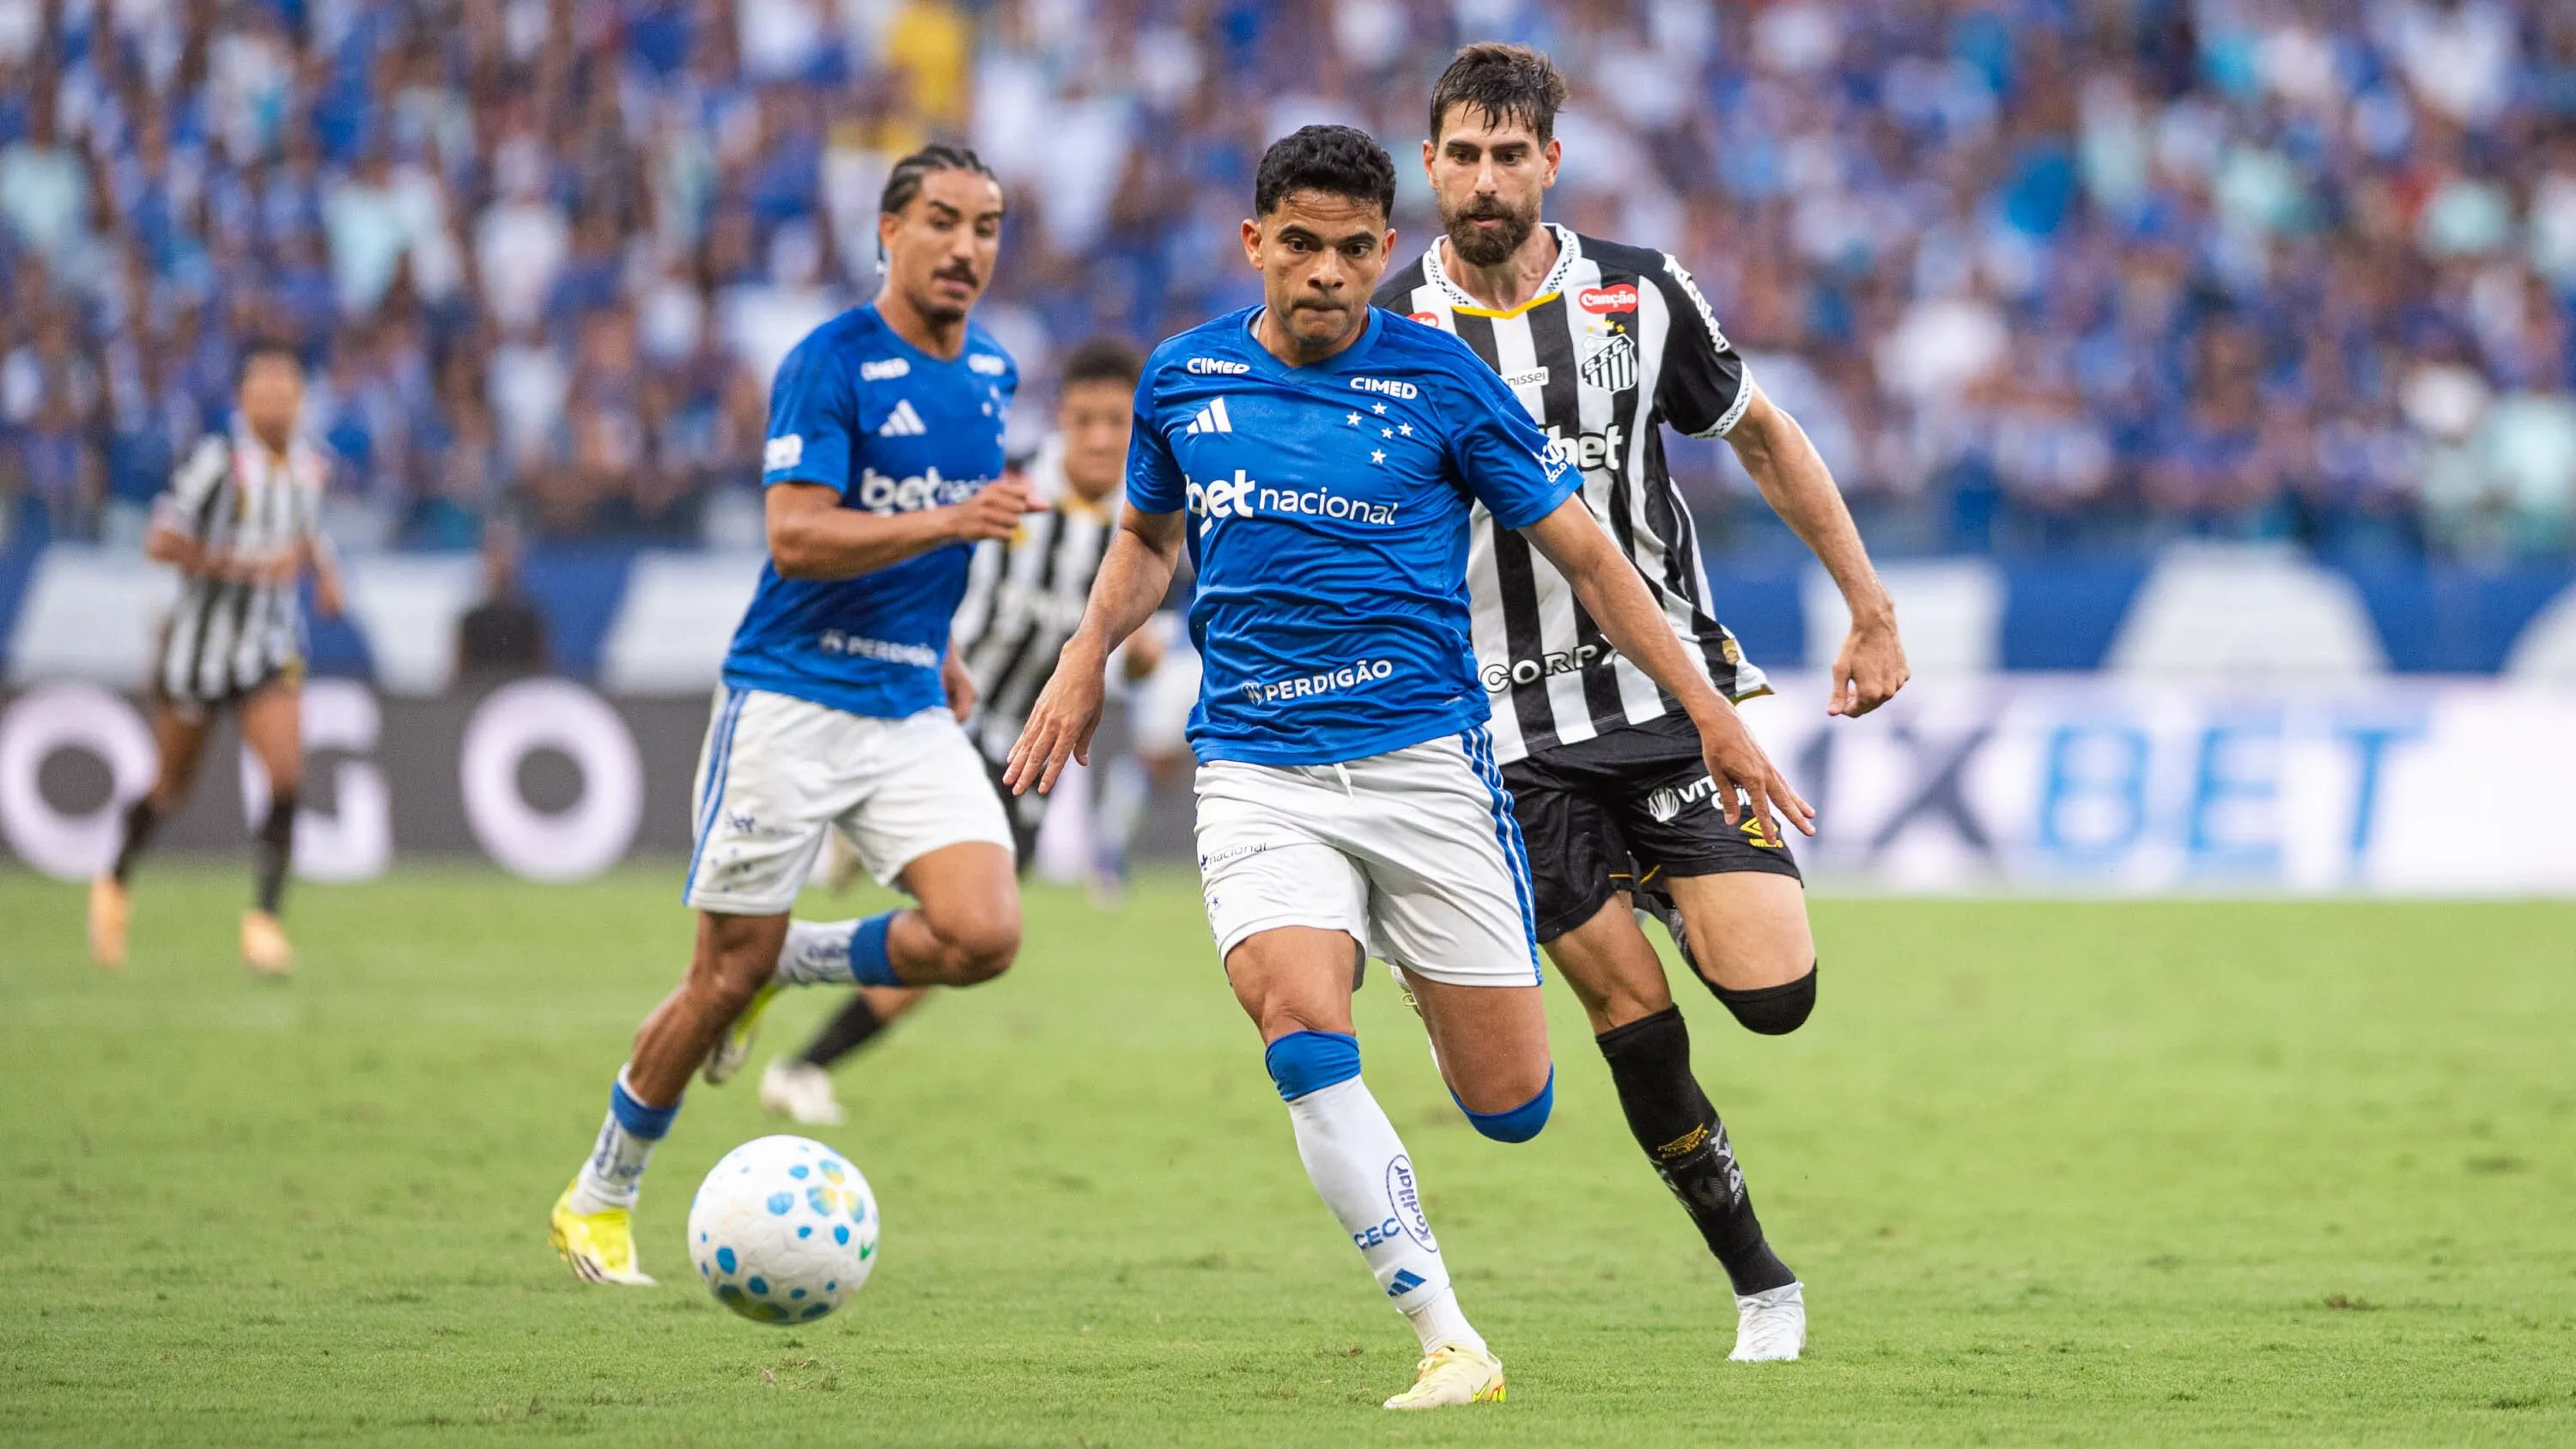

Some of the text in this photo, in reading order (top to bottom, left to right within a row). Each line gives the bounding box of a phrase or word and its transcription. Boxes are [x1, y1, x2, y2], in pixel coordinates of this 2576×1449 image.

[1581, 290, 1637, 308] Canção
[1187, 357, 1250, 374] CIMED
[1350, 377, 1418, 400] CIMED
[1538, 424, 1623, 471] bet
[1185, 470, 1398, 526] bet nacional
[1265, 660, 1393, 702] PERDIGÃO
[1679, 775, 1717, 803] VIT
[1209, 843, 1267, 865] nacional
[1394, 1166, 1432, 1242] Kodilar
[1353, 1217, 1401, 1251] CEC
